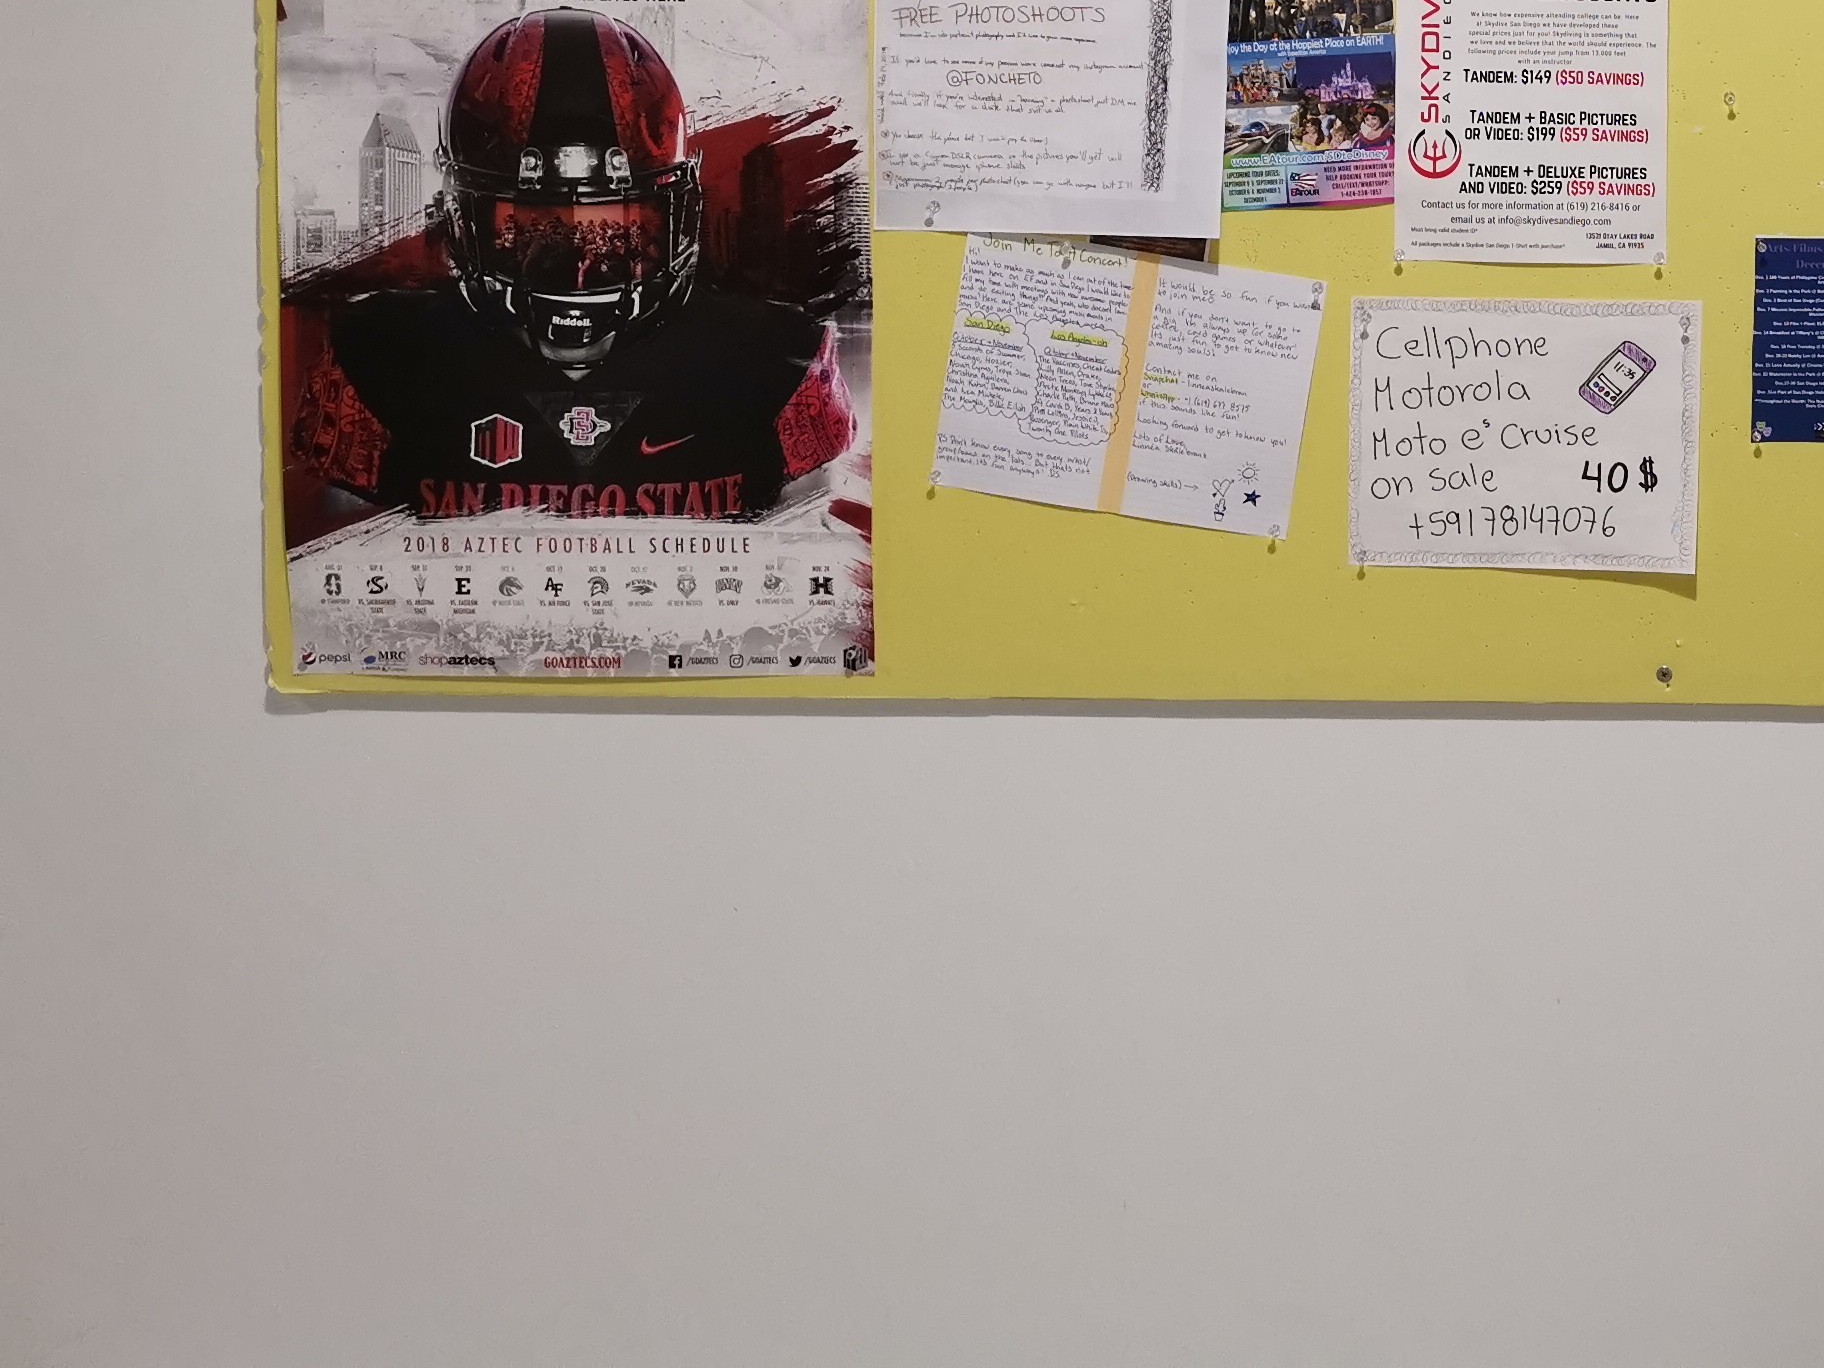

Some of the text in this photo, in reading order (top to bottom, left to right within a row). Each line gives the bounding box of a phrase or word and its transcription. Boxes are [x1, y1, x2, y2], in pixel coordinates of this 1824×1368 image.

[891, 3, 1106, 28] FREE PHOTOSHOOTS
[946, 70, 1042, 86] @FONCHETO
[1376, 326, 1549, 369] Cellphone
[1374, 370, 1531, 412] Motorola
[1581, 456, 1658, 493] 40 $
[1409, 504, 1616, 539] +59178147076
[403, 536, 751, 555] 2018 AZTEC FOOTBALL SCHEDULE
[318, 653, 621, 669] pepsi shopaztecs GOAZTECS.COM
